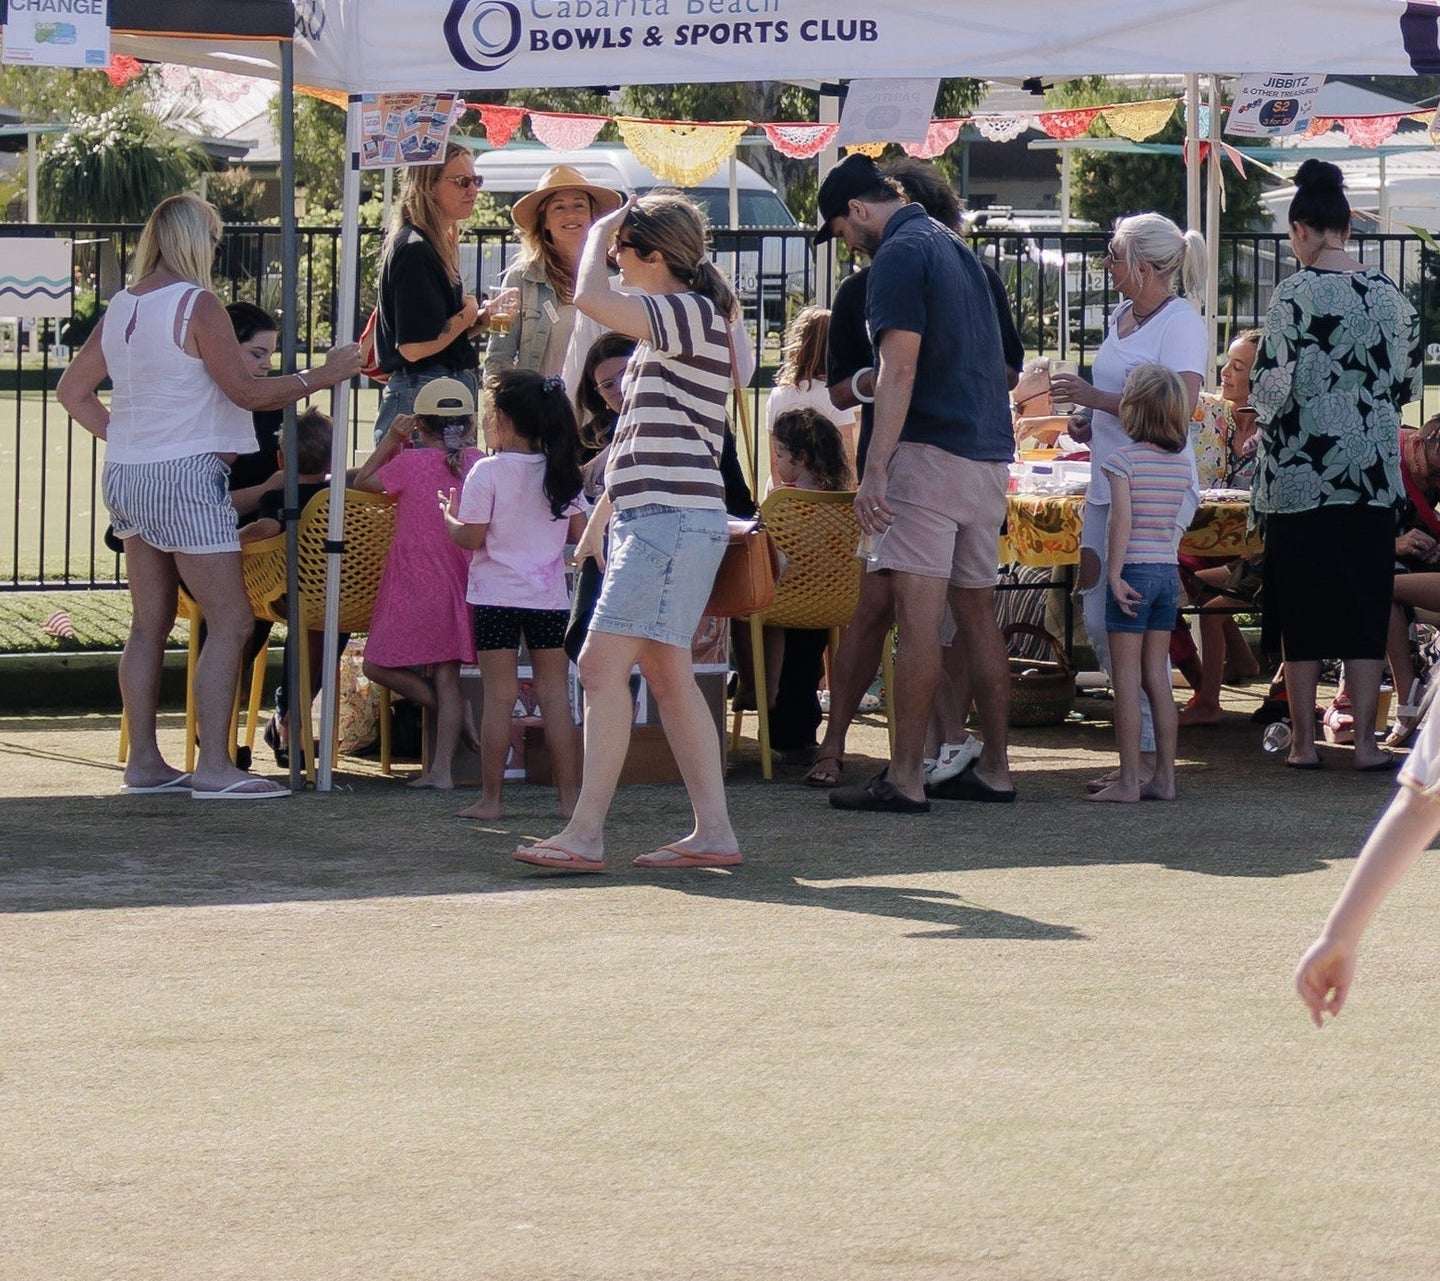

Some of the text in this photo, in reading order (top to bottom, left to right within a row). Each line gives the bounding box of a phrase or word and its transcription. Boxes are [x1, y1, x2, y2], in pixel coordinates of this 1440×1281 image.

[529, 19, 879, 52] BOWLS & SPORTS CLUB
[1262, 76, 1310, 89] JIBBITZ
[1250, 87, 1279, 98] OTHER
